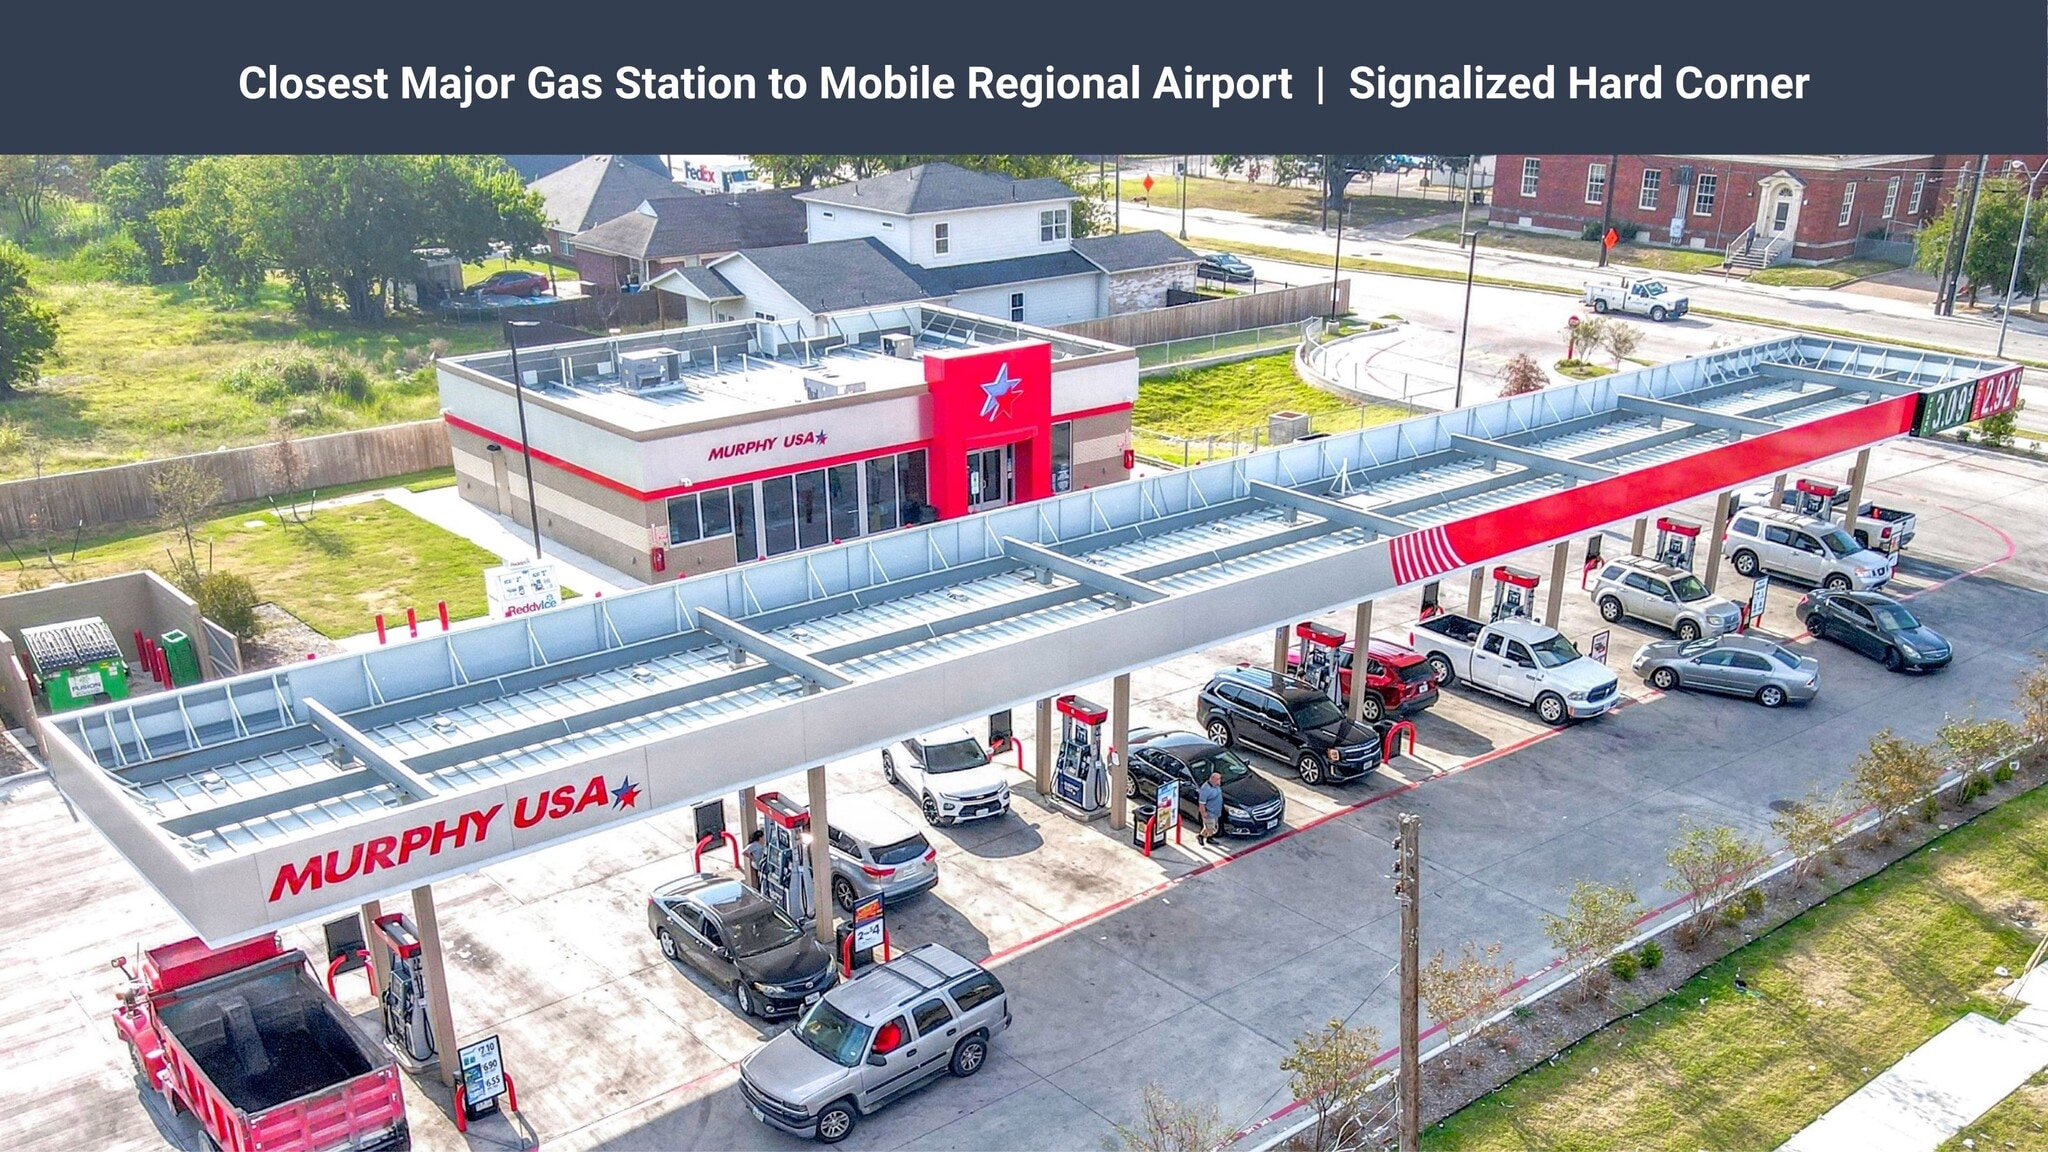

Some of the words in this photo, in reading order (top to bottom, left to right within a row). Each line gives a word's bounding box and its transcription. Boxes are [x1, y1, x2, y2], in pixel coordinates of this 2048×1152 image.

[684, 160, 716, 184] FedEx
[708, 437, 778, 461] MURPHY
[783, 431, 815, 448] USA
[268, 803, 504, 903] MURPHY
[512, 775, 610, 829] USA
